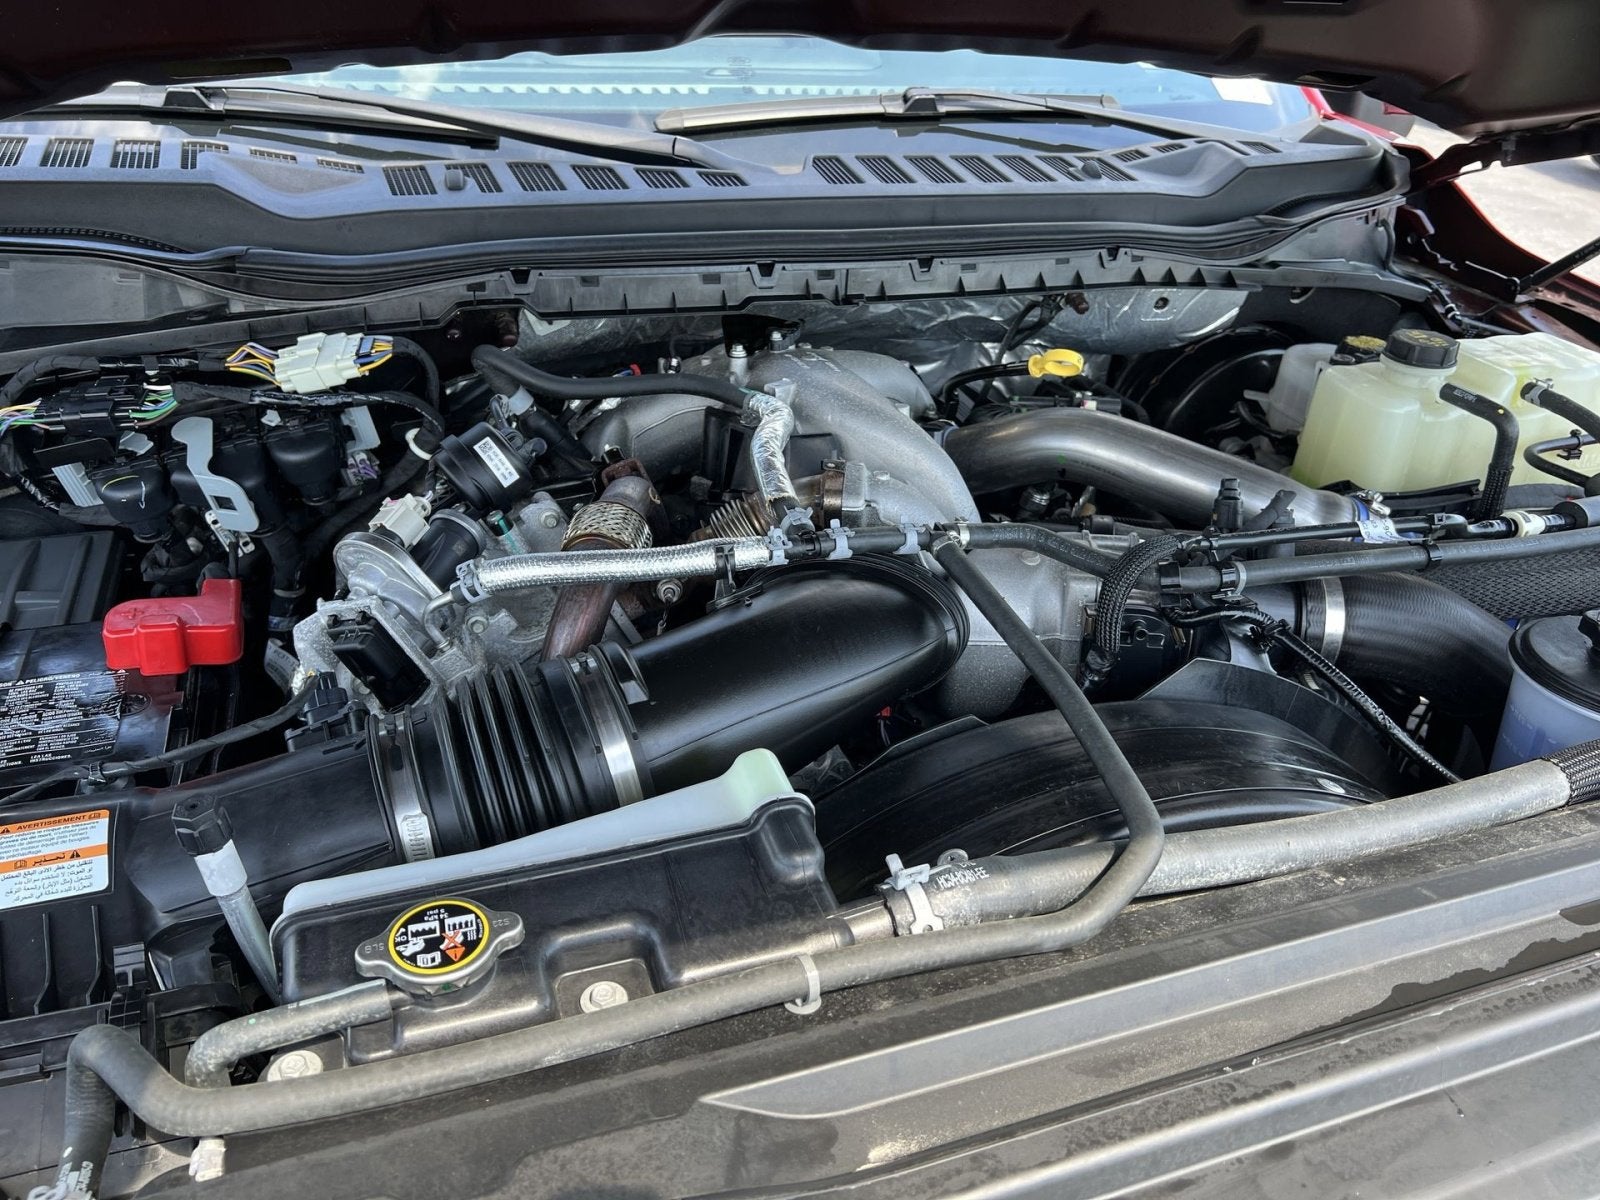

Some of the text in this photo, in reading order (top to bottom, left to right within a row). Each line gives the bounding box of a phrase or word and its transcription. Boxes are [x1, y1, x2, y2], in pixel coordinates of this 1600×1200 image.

[16, 814, 87, 831] AVERTISSEMENT
[439, 912, 449, 920] 34
[394, 935, 407, 943] OK
